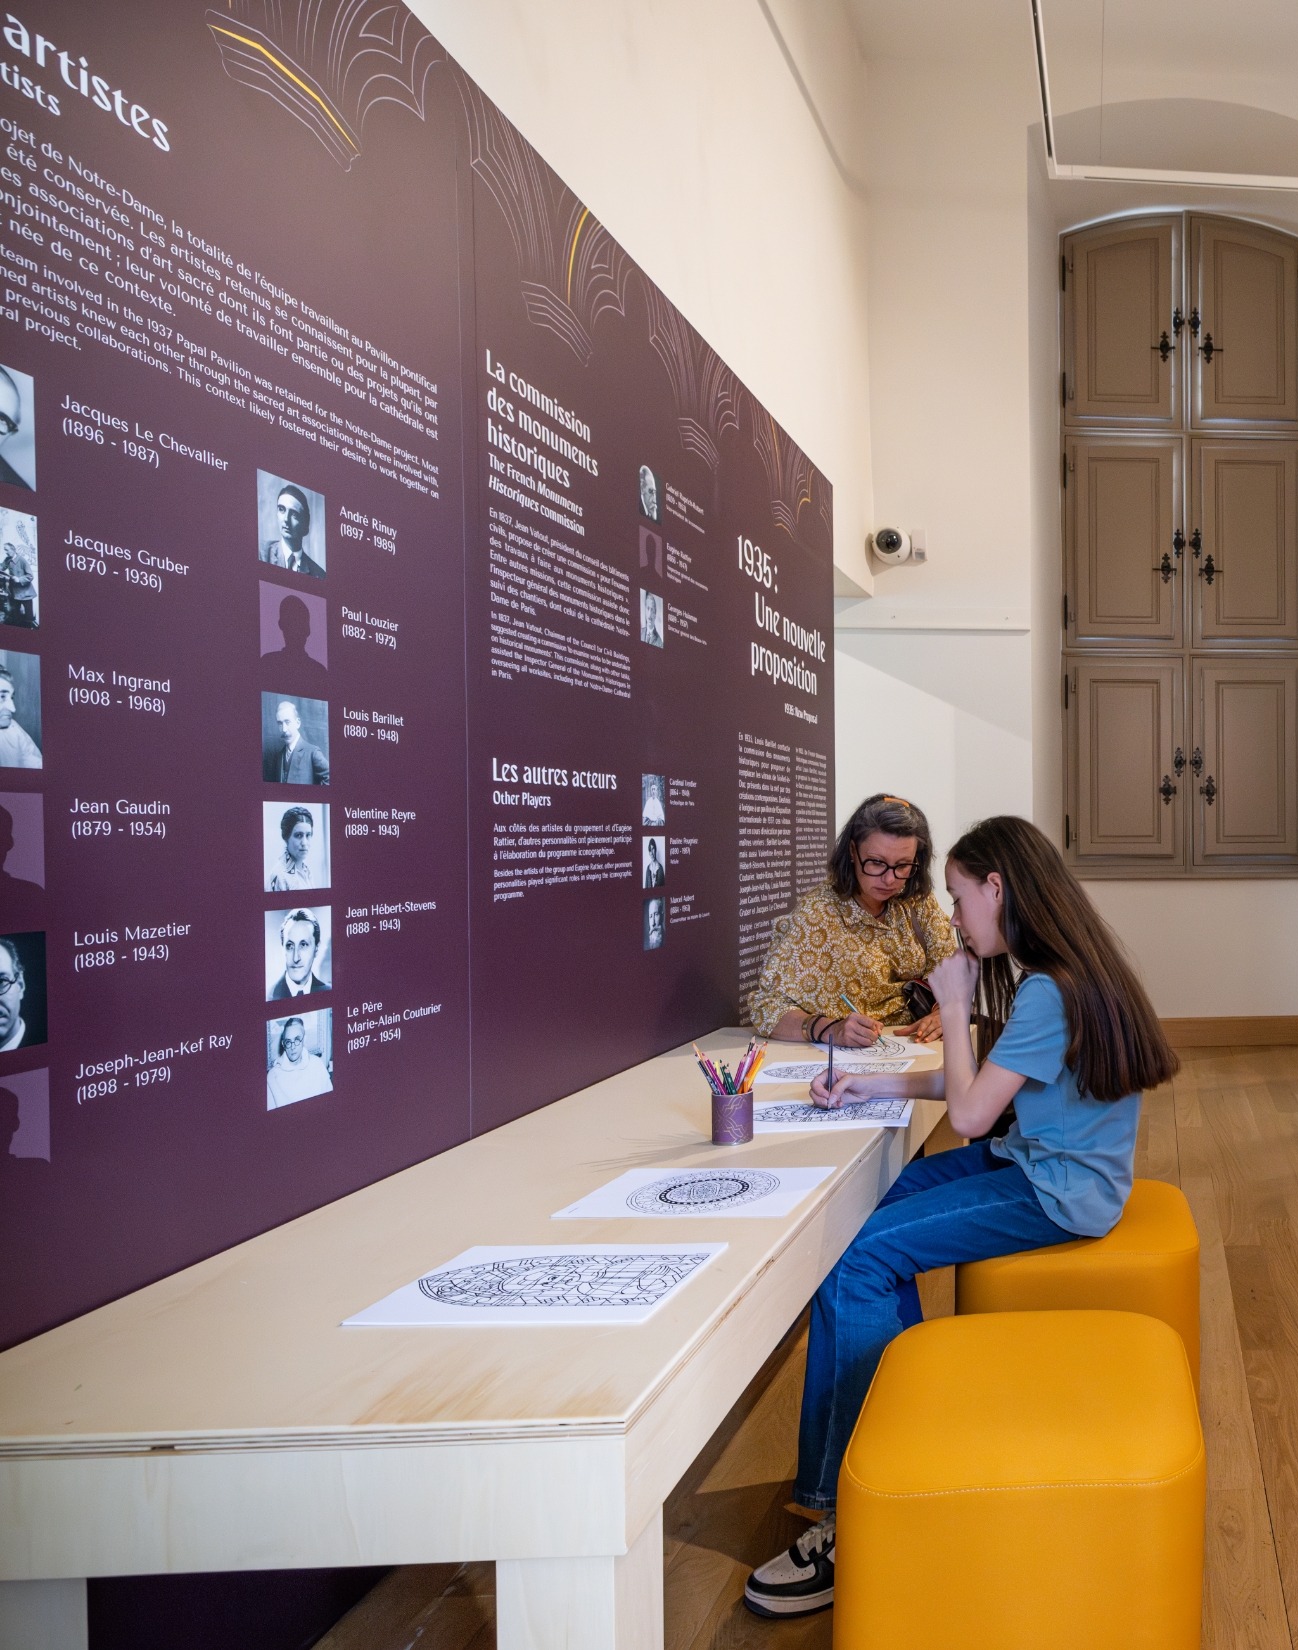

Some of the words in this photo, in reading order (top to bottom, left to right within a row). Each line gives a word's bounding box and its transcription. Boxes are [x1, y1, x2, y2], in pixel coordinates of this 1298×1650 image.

[3, 13, 170, 152] artistes
[6, 143, 37, 171] été
[43, 168, 133, 229] conservée.
[140, 221, 165, 248] Les
[170, 243, 221, 280] artistes
[225, 275, 271, 310] retenus
[274, 305, 287, 320] se
[291, 316, 353, 359] connaissent
[355, 354, 377, 372] pour
[380, 366, 388, 380] la
[390, 375, 422, 401] plupart,
[424, 395, 438, 409] par
[9, 219, 43, 246] née
[50, 240, 72, 261] de
[78, 257, 98, 275] ce
[104, 271, 176, 316] contexte.
[40, 142, 62, 164] de
[68, 155, 166, 230] Notre-Dame,
[172, 219, 183, 238] la
[186, 230, 233, 268] totalité
[236, 262, 251, 279] de
[300, 301, 349, 340] travaillant
[351, 334, 362, 348] au
[365, 340, 398, 370] Pavillon
[400, 365, 437, 394] pontifical
[28, 182, 134, 251] associations
[177, 268, 214, 296] sacré
[218, 291, 248, 316] dont
[252, 307, 265, 326] ils
[269, 318, 293, 342] font
[296, 336, 328, 361] partie
[330, 357, 344, 371] ou
[346, 365, 364, 382] des
[366, 377, 398, 402] projets
[424, 411, 438, 425] ont
[25, 317, 81, 350] project.
[126, 256, 155, 283] leur
[159, 278, 212, 315] volonté
[216, 309, 232, 326] de
[236, 318, 288, 356] travailler
[291, 352, 341, 386] ensemble
[344, 381, 366, 399] pour
[369, 392, 377, 406] la
[379, 401, 424, 432] cathédrale
[425, 427, 438, 440] est
[486, 348, 505, 384] La
[509, 372, 590, 443] commission
[60, 394, 128, 432] Jacques
[135, 422, 153, 441] Le
[158, 433, 228, 470] Chevallier
[62, 417, 104, 444] (1896
[122, 439, 159, 468] 1987)
[487, 386, 514, 422] des
[518, 410, 598, 476] monuments
[487, 417, 570, 488] historiques
[488, 452, 505, 474] The
[506, 463, 535, 491] French
[536, 480, 582, 516] Monuments
[488, 475, 539, 512] Historiques
[540, 504, 584, 536] commission
[339, 505, 368, 526] André
[372, 517, 397, 540] Rinuy
[340, 522, 363, 540] (1897
[373, 535, 395, 555] 1989)
[64, 529, 131, 560] Jacques
[137, 549, 189, 575] Gruber
[66, 552, 106, 575] (1870
[124, 567, 162, 592] 1936)
[341, 606, 361, 622] Paul
[365, 612, 398, 631] Louzier
[754, 591, 780, 636] Une
[782, 616, 825, 662] nouvelle
[342, 623, 366, 640] (1882
[375, 632, 396, 650] 1972)
[68, 663, 104, 683] Max
[112, 670, 170, 692] Ingrand
[750, 641, 817, 695] proposition
[69, 687, 110, 706] (1908
[128, 695, 165, 716] 1968)
[343, 706, 369, 721] Louis
[372, 711, 404, 726] Barillet
[343, 724, 367, 738] (1880
[377, 728, 398, 744] 1948)
[492, 757, 518, 782] Les
[522, 765, 568, 786] autres
[571, 770, 616, 790] acteurs
[69, 798, 108, 813] Jean
[115, 799, 170, 814] Gaudin
[344, 806, 388, 819] Valentine
[391, 808, 416, 823] Reyre
[492, 790, 520, 805] Other
[521, 791, 551, 808] Players
[71, 820, 111, 839] (1879
[129, 821, 165, 839] 1954)
[344, 823, 368, 838] (1889
[378, 824, 399, 838] 1943)
[345, 906, 368, 918] Jean
[371, 901, 436, 915] Hébert-Stevens
[74, 928, 118, 946] Louis
[125, 922, 190, 940] Mazetier
[346, 921, 369, 937] (1888
[379, 918, 400, 931] 1943)
[74, 950, 115, 972] (1888
[132, 944, 168, 961] 1943)
[347, 1006, 358, 1017] Le
[362, 1001, 382, 1014] Père
[347, 1012, 400, 1034] Marie-Alain
[402, 1003, 441, 1020] Couturier
[75, 1037, 204, 1079] Joseph-Jean-Kef
[209, 1034, 232, 1049] Ray
[347, 1034, 370, 1054] (1897
[379, 1027, 400, 1042] 1954)
[77, 1078, 117, 1104] (1898
[134, 1065, 170, 1086] 1979)
